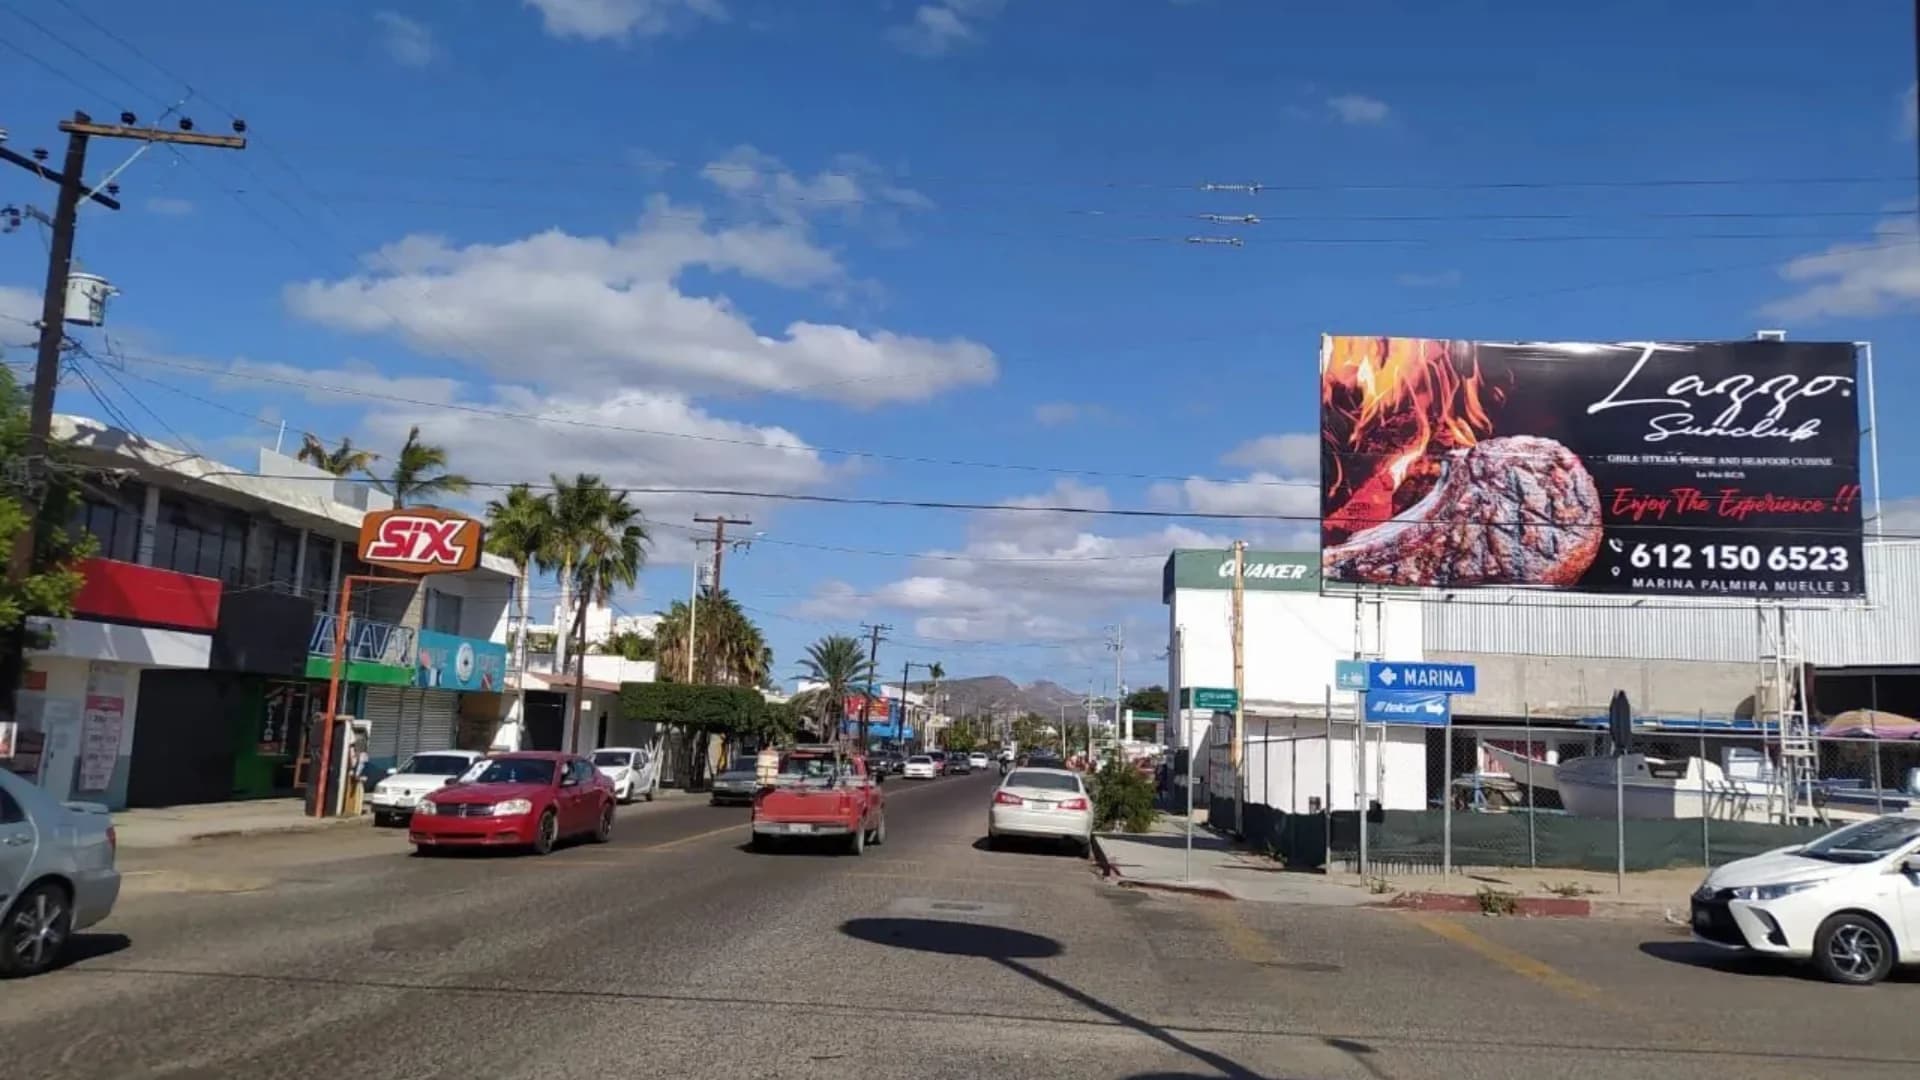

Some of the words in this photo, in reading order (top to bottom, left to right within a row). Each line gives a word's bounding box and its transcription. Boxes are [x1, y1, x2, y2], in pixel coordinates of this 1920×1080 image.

[1643, 413, 1821, 442] Sunclub
[1642, 454, 1678, 464] STEAK
[1718, 456, 1740, 465] AND
[1741, 456, 1790, 466] SEAFOOD
[1791, 457, 1833, 466] CUISINE
[1611, 487, 1671, 521] Enjoy
[1669, 487, 1711, 515] The
[1718, 488, 1825, 521] Experience
[1630, 543, 1692, 569] 612
[1701, 544, 1761, 571] 150
[1767, 546, 1849, 572] 6523
[1632, 577, 1695, 589] MARINA
[1701, 579, 1768, 592] PALMIRA
[1774, 580, 1835, 593] MUELLE
[1842, 581, 1850, 593] 3
[1404, 667, 1465, 687] MARINA
